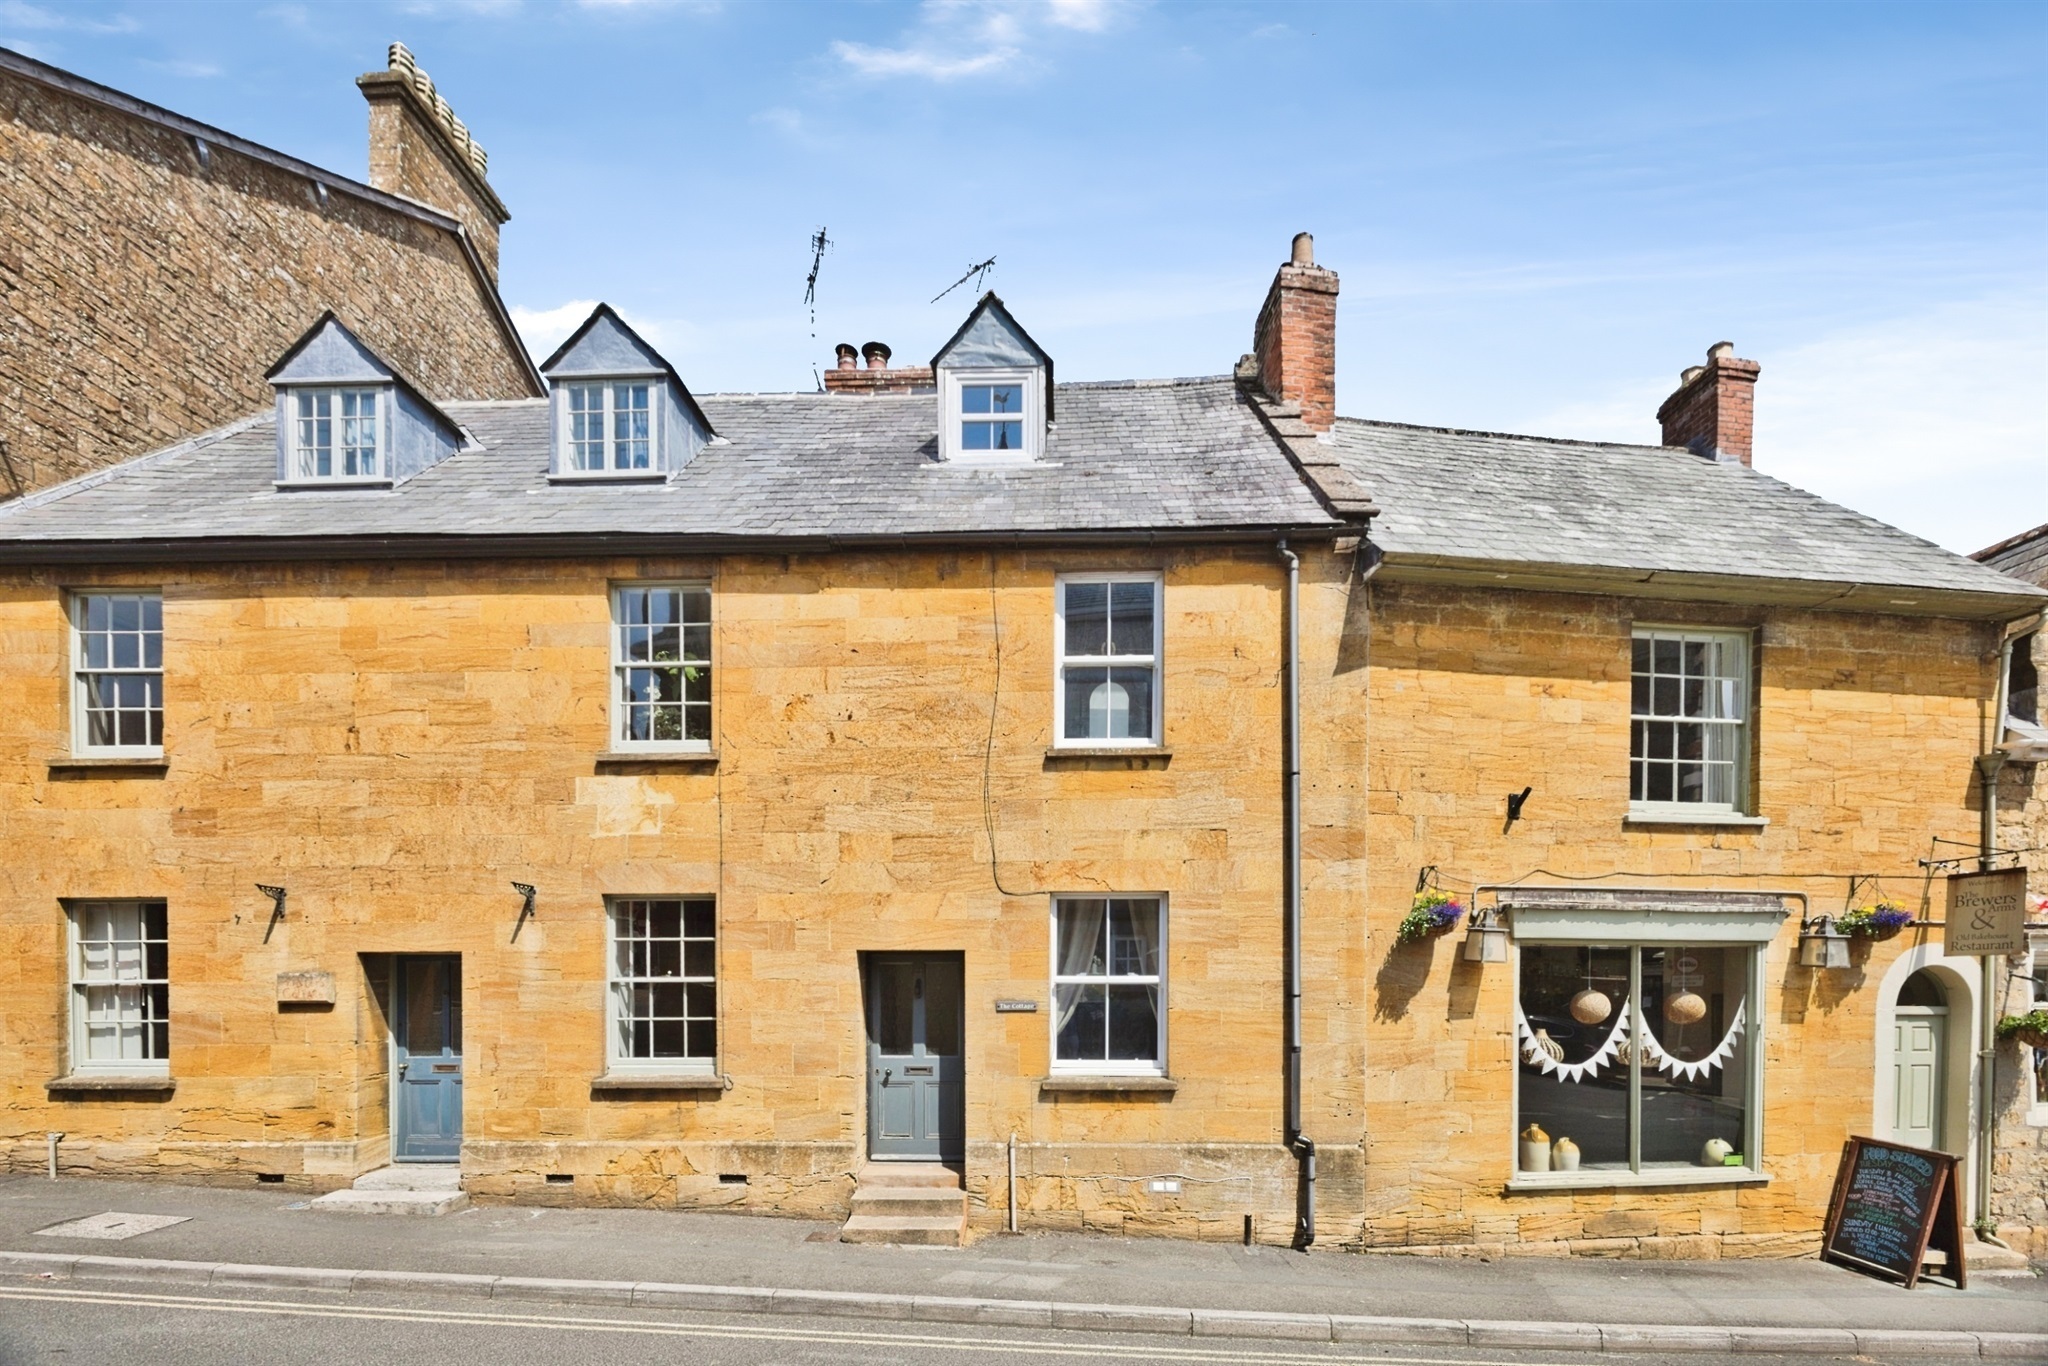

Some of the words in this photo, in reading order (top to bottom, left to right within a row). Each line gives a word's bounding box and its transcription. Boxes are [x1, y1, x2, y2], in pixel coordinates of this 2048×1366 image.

[1954, 894, 2017, 908] Brewers
[1988, 904, 2016, 912] Arms
[1970, 908, 1996, 930] &
[1971, 932, 2009, 940] Bakehouse
[1951, 941, 2014, 951] Restaurant
[1863, 1147, 1890, 1160] FOOD
[1889, 1150, 1933, 1177] SERVED
[1844, 1218, 1874, 1228] SUNDAY
[1874, 1223, 1909, 1243] LUNCHES
[1875, 1254, 1890, 1265] FREE
